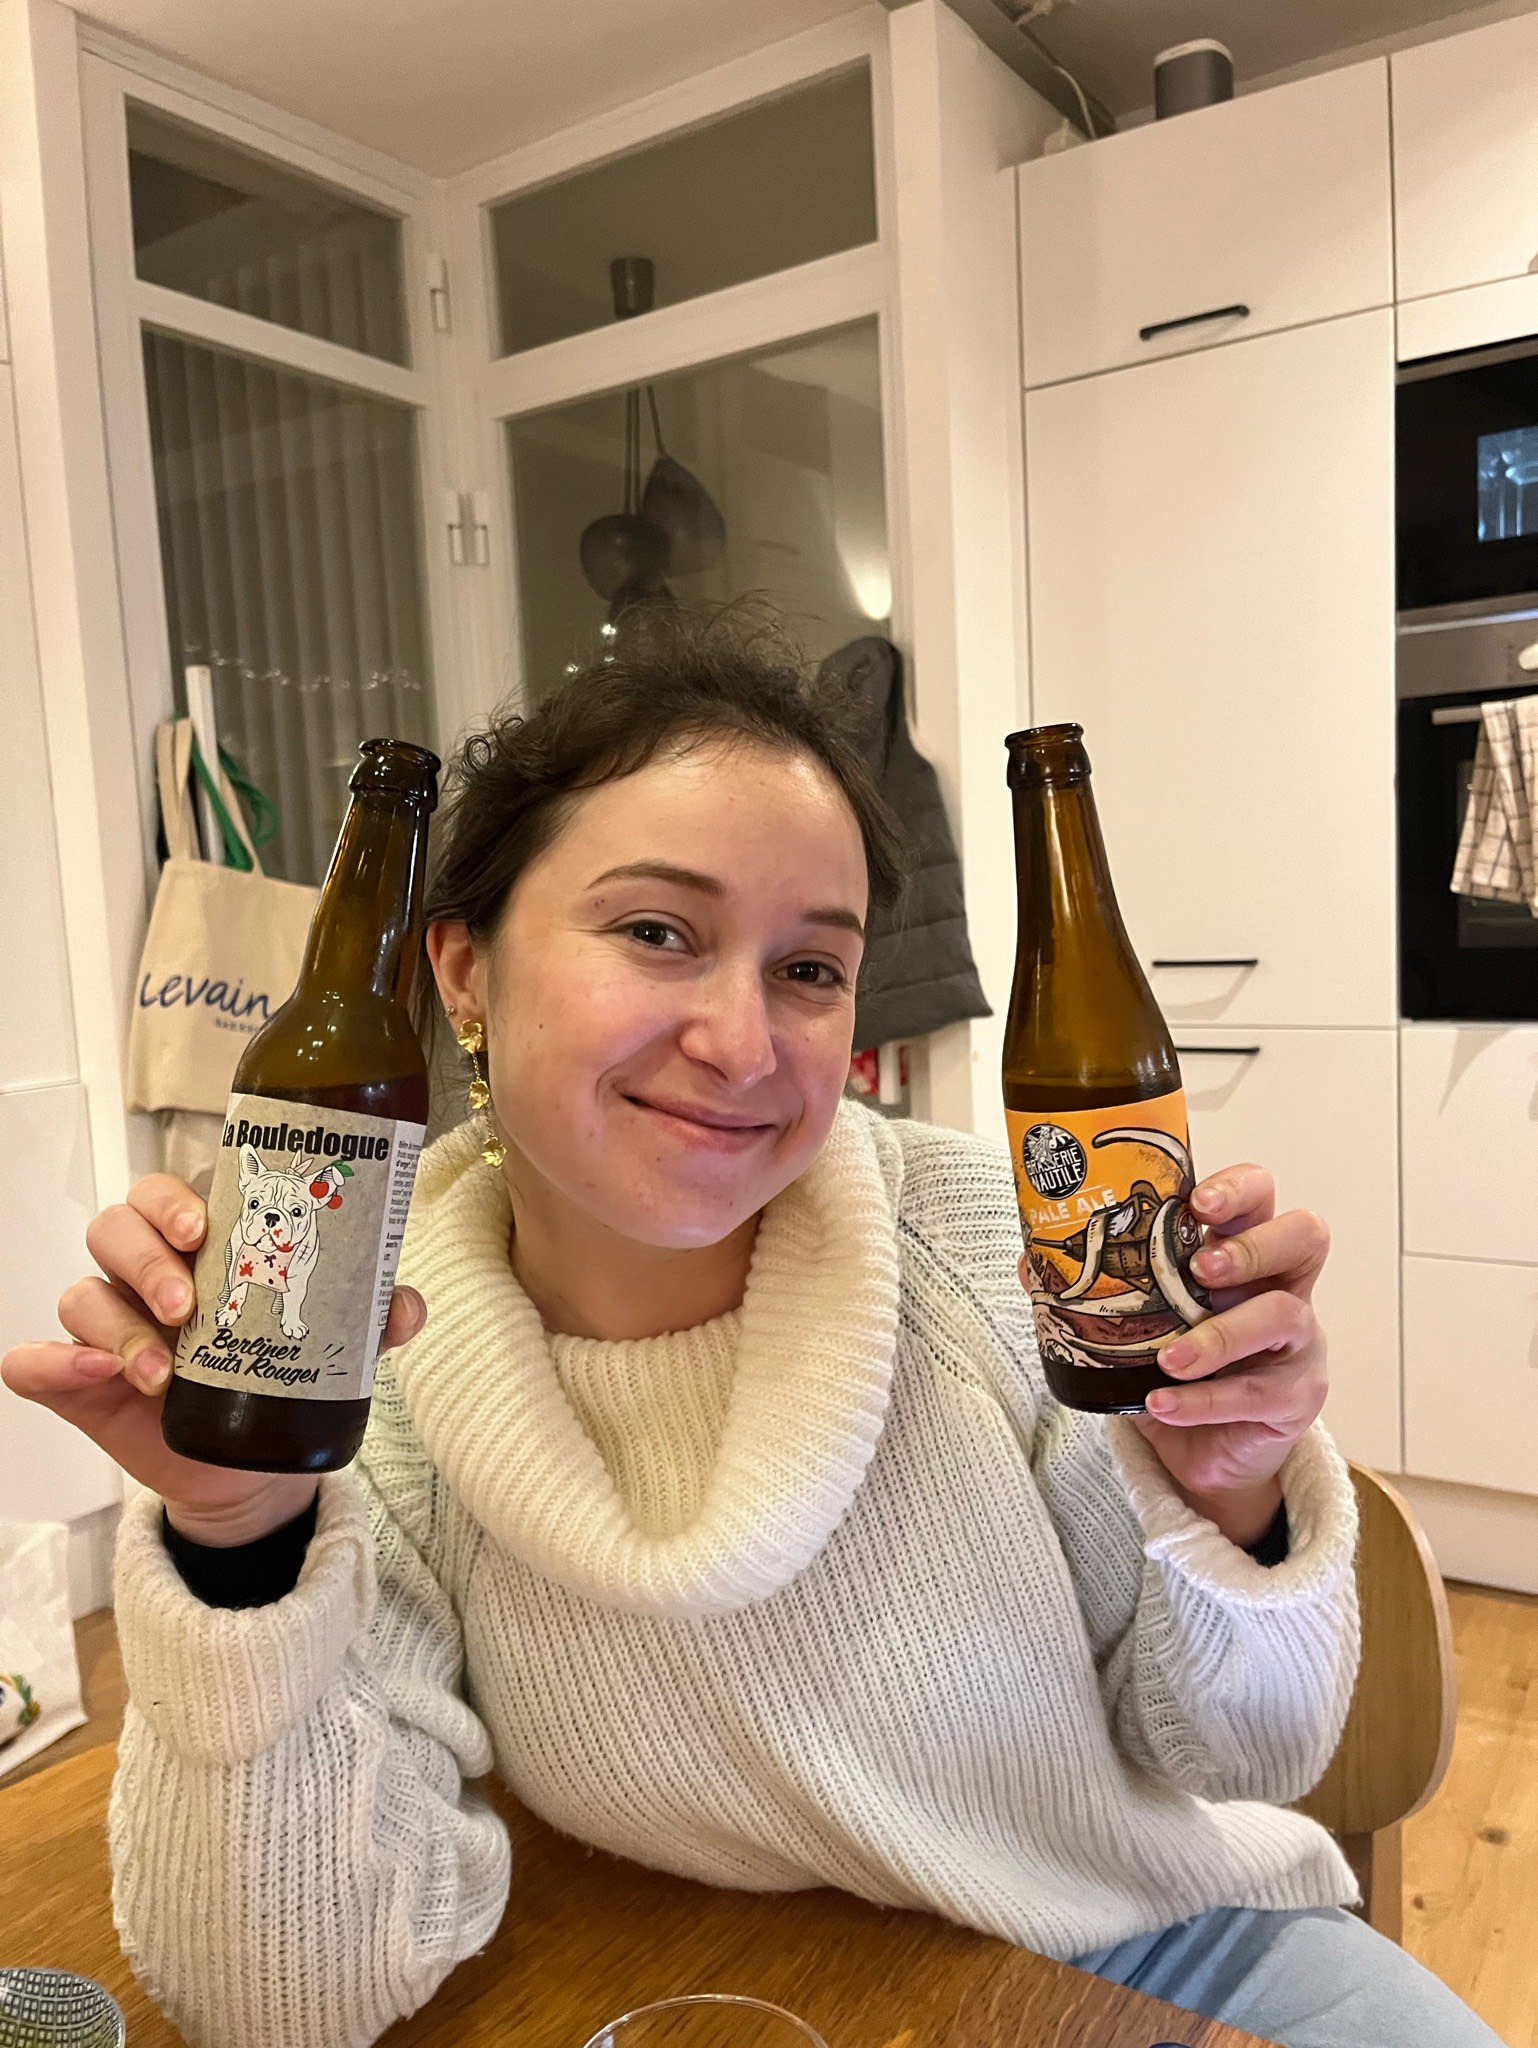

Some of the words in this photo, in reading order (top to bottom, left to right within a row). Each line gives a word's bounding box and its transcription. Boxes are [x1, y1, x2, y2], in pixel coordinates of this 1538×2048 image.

[140, 971, 271, 1020] Levain
[236, 1120, 389, 1161] Bouledogue
[1026, 1147, 1082, 1176] BRASSERIE
[1031, 1162, 1084, 1192] NAUTILE
[1029, 1202, 1070, 1225] PALE
[1077, 1189, 1117, 1216] ALE
[212, 1328, 302, 1361] Berliner
[190, 1345, 243, 1374] Fruits
[244, 1356, 320, 1386] Rouges
